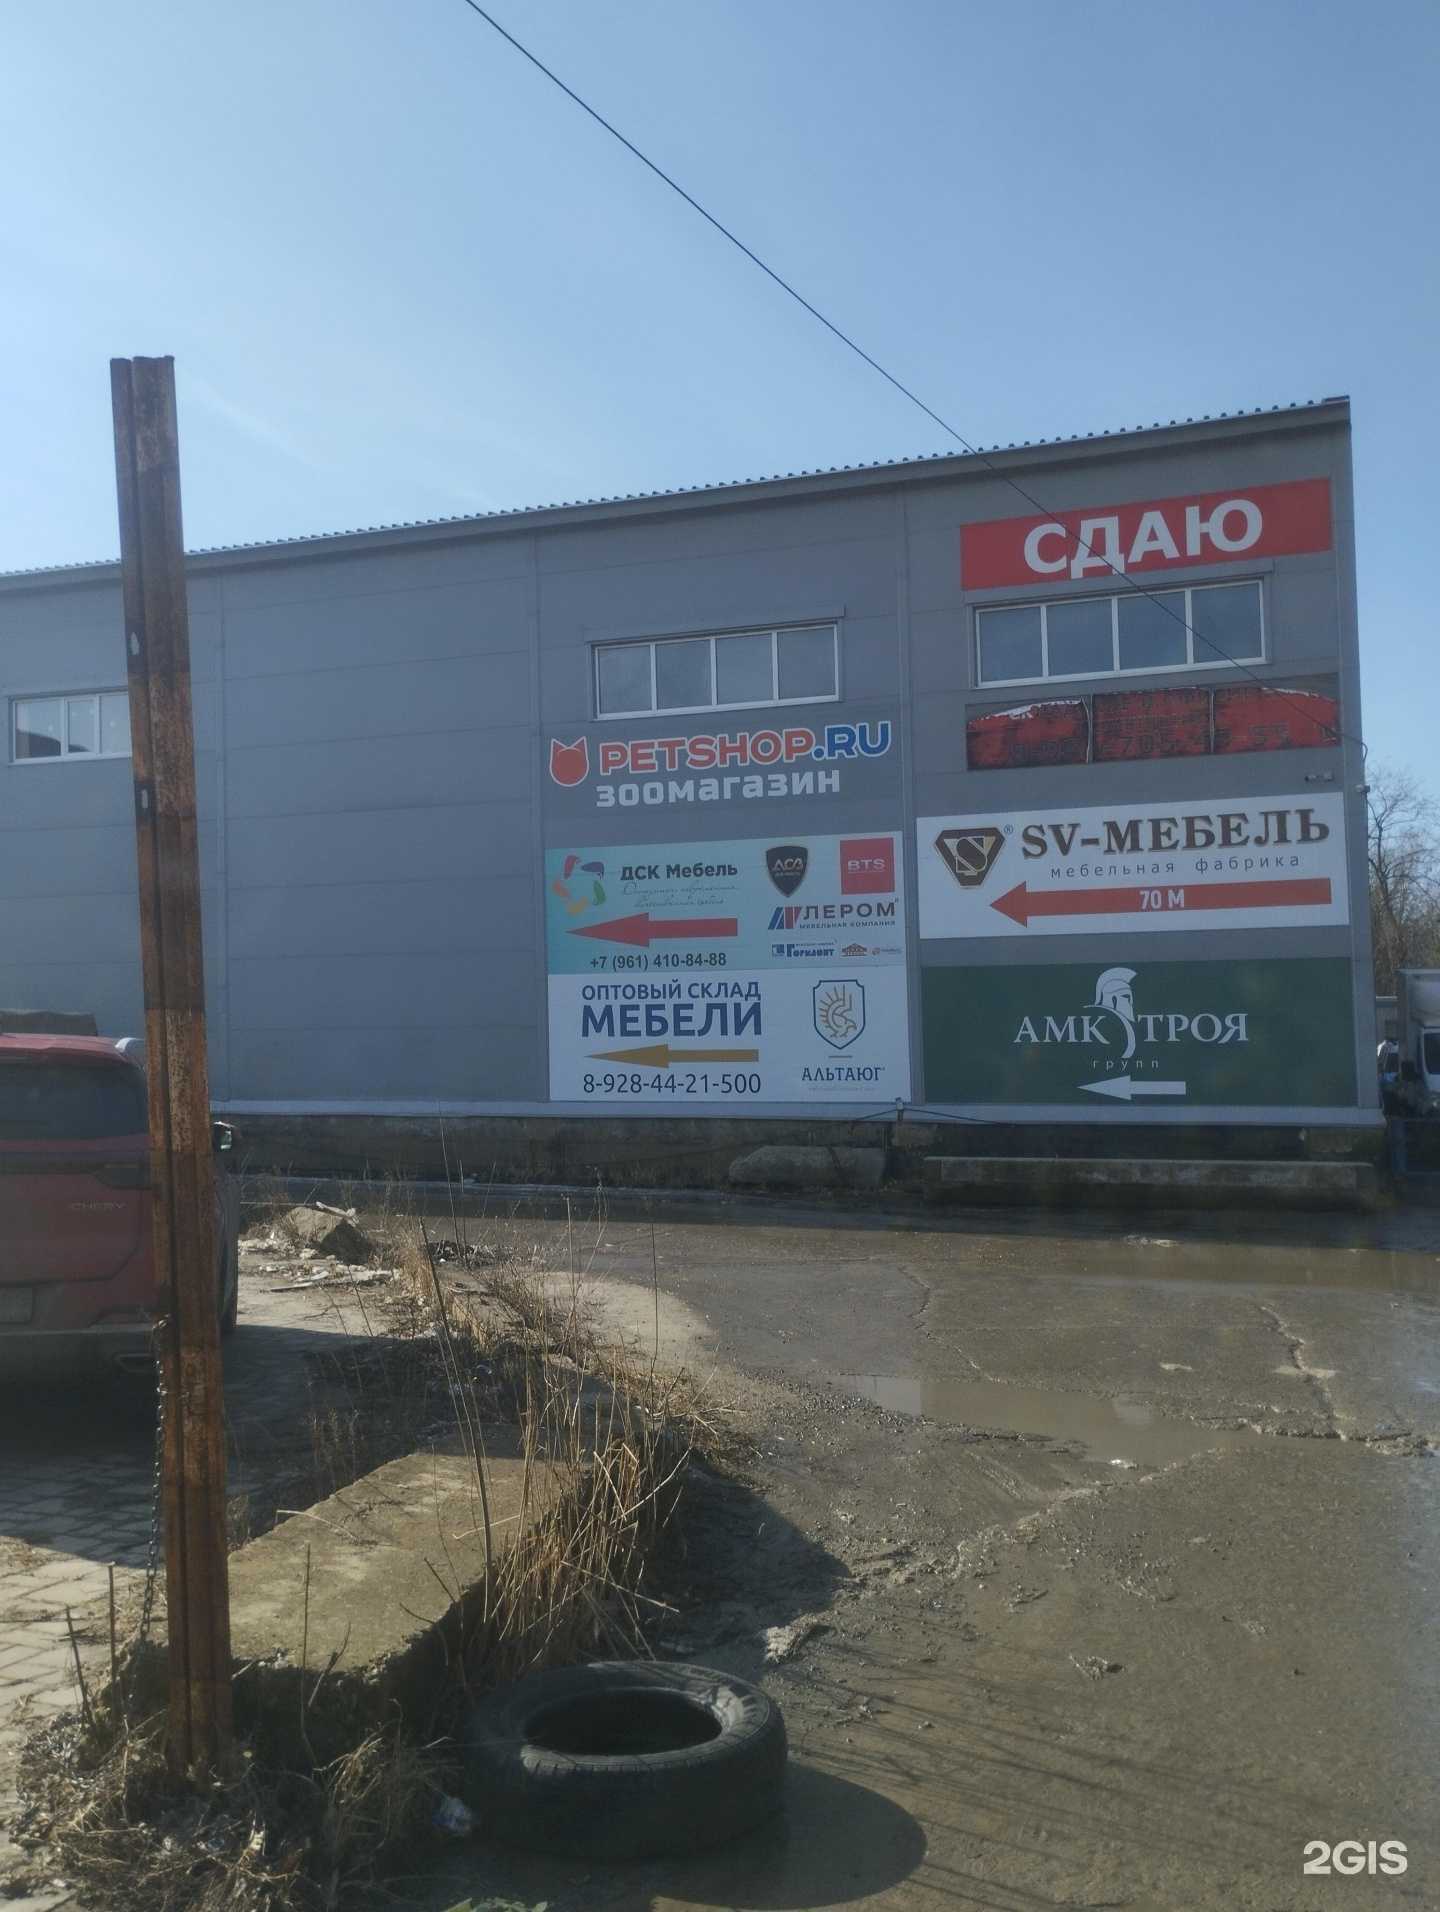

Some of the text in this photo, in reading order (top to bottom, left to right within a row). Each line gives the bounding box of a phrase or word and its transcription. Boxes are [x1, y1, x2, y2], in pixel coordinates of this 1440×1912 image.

[1023, 498, 1263, 579] СДАЮ
[599, 720, 892, 776] PETSHOP.RU
[595, 769, 841, 808] зоомагазин
[1021, 808, 1330, 860] SV-МЕБЕЛЬ
[620, 862, 738, 881] ДСК Мебель
[847, 858, 886, 871] BTS
[1050, 854, 1301, 879] мебельная фабрика
[803, 902, 895, 920] ЛЕРОМ
[1139, 889, 1185, 911] 70 М
[590, 952, 727, 972] +7 (961) 410-84-88
[581, 979, 762, 1002] ОПТОВЫЙ СКЛАД
[581, 1001, 763, 1038] МЕБЕЛИ
[1013, 1012, 1249, 1045] АМК ТРОЯ
[801, 1067, 882, 1081] АЛЬТАЮГ
[1092, 1059, 1160, 1072] групп
[583, 1073, 762, 1094] 8-928-44-21-500
